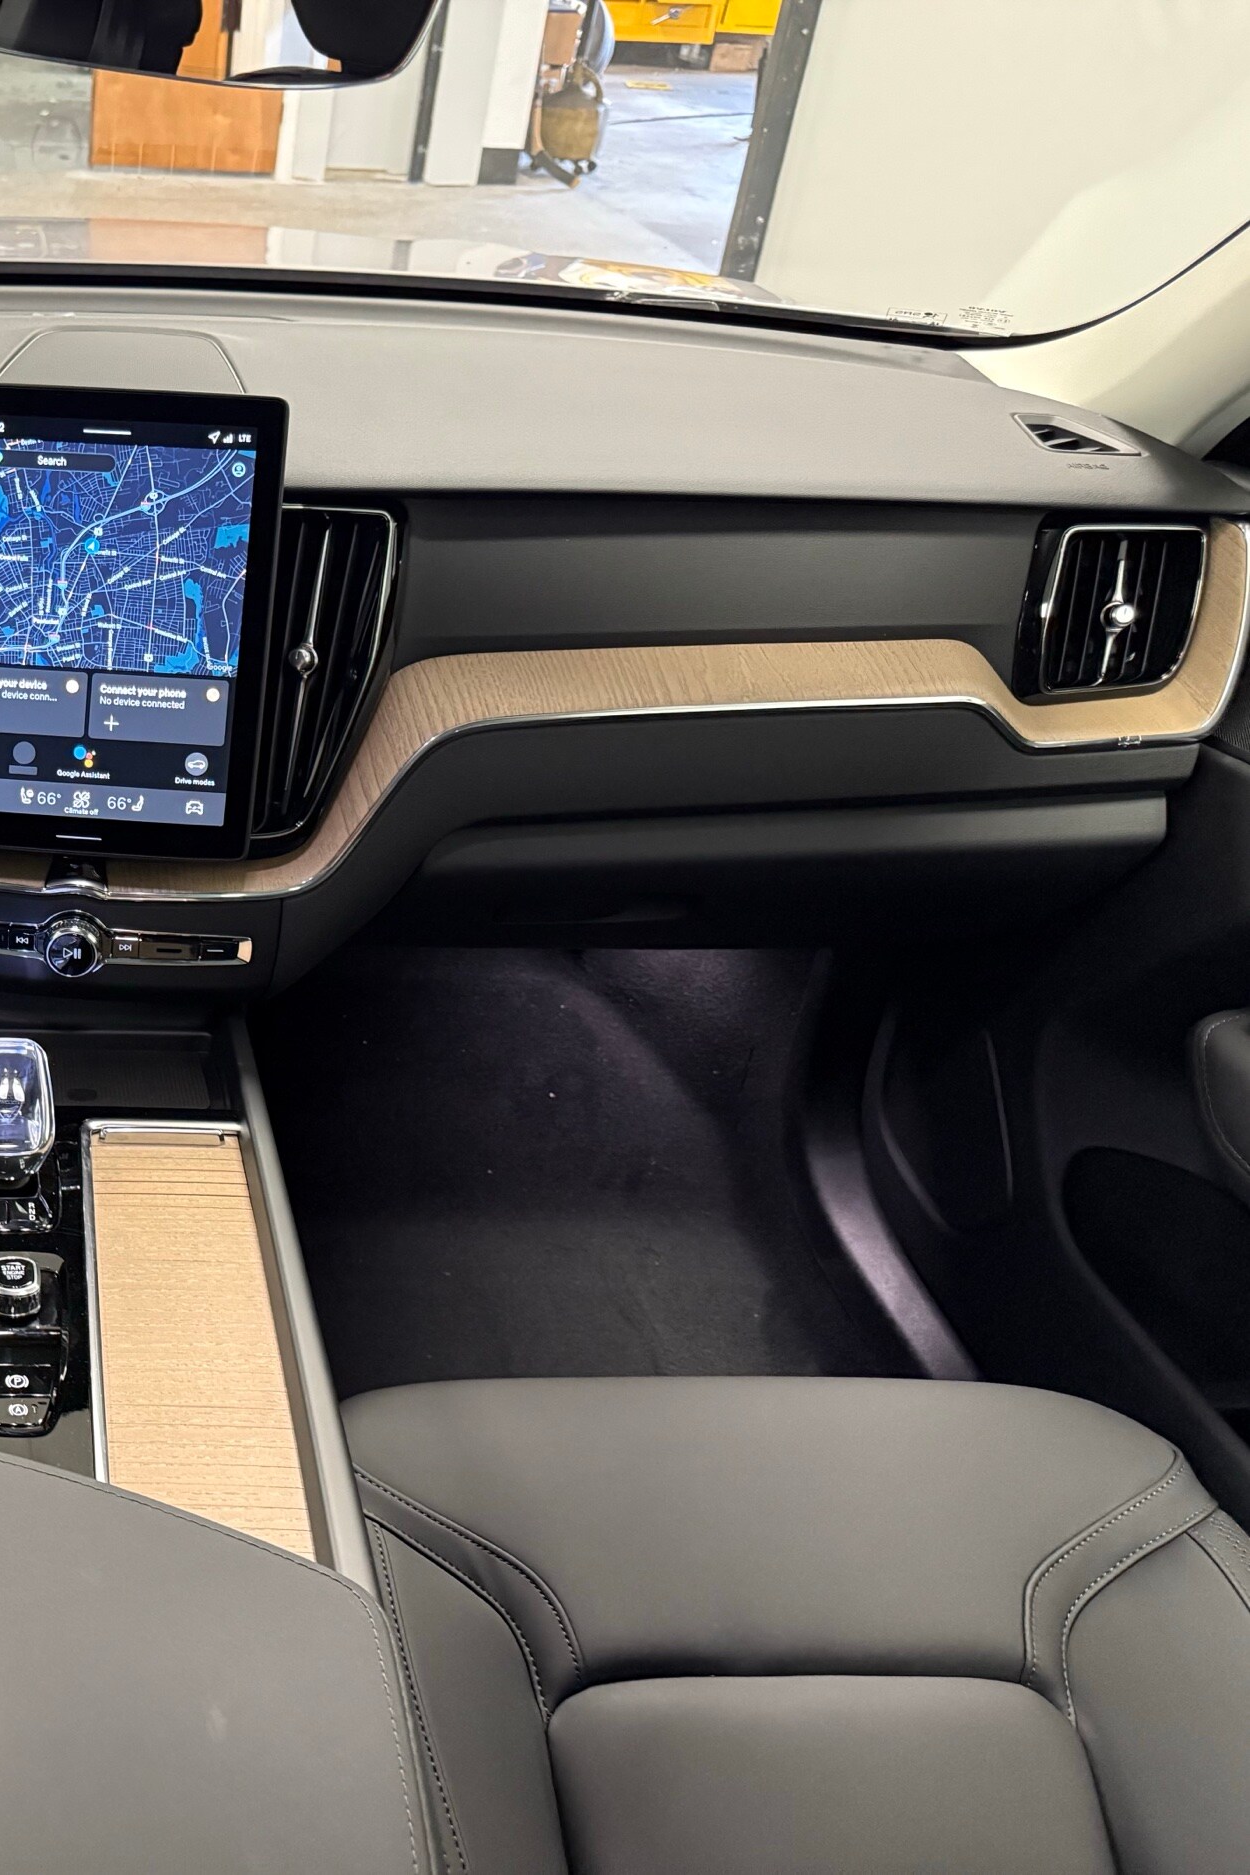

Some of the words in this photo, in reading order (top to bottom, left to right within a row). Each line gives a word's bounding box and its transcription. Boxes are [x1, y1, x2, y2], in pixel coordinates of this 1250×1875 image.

[238, 433, 252, 443] LTE
[37, 454, 67, 466] Search
[207, 661, 233, 672] Google
[18, 679, 48, 690] device
[1, 690, 28, 700] device
[99, 683, 137, 696] Connect
[137, 687, 158, 698] your
[158, 687, 187, 699] phone
[99, 695, 111, 705] No
[113, 697, 140, 707] device
[141, 699, 185, 709] connected
[56, 769, 80, 779] Google
[80, 770, 111, 780] Assistant
[174, 777, 192, 786] Drive
[192, 778, 216, 787] modes
[63, 807, 88, 816] Climate
[88, 808, 99, 816] off
[0, 1264, 26, 1272] START
